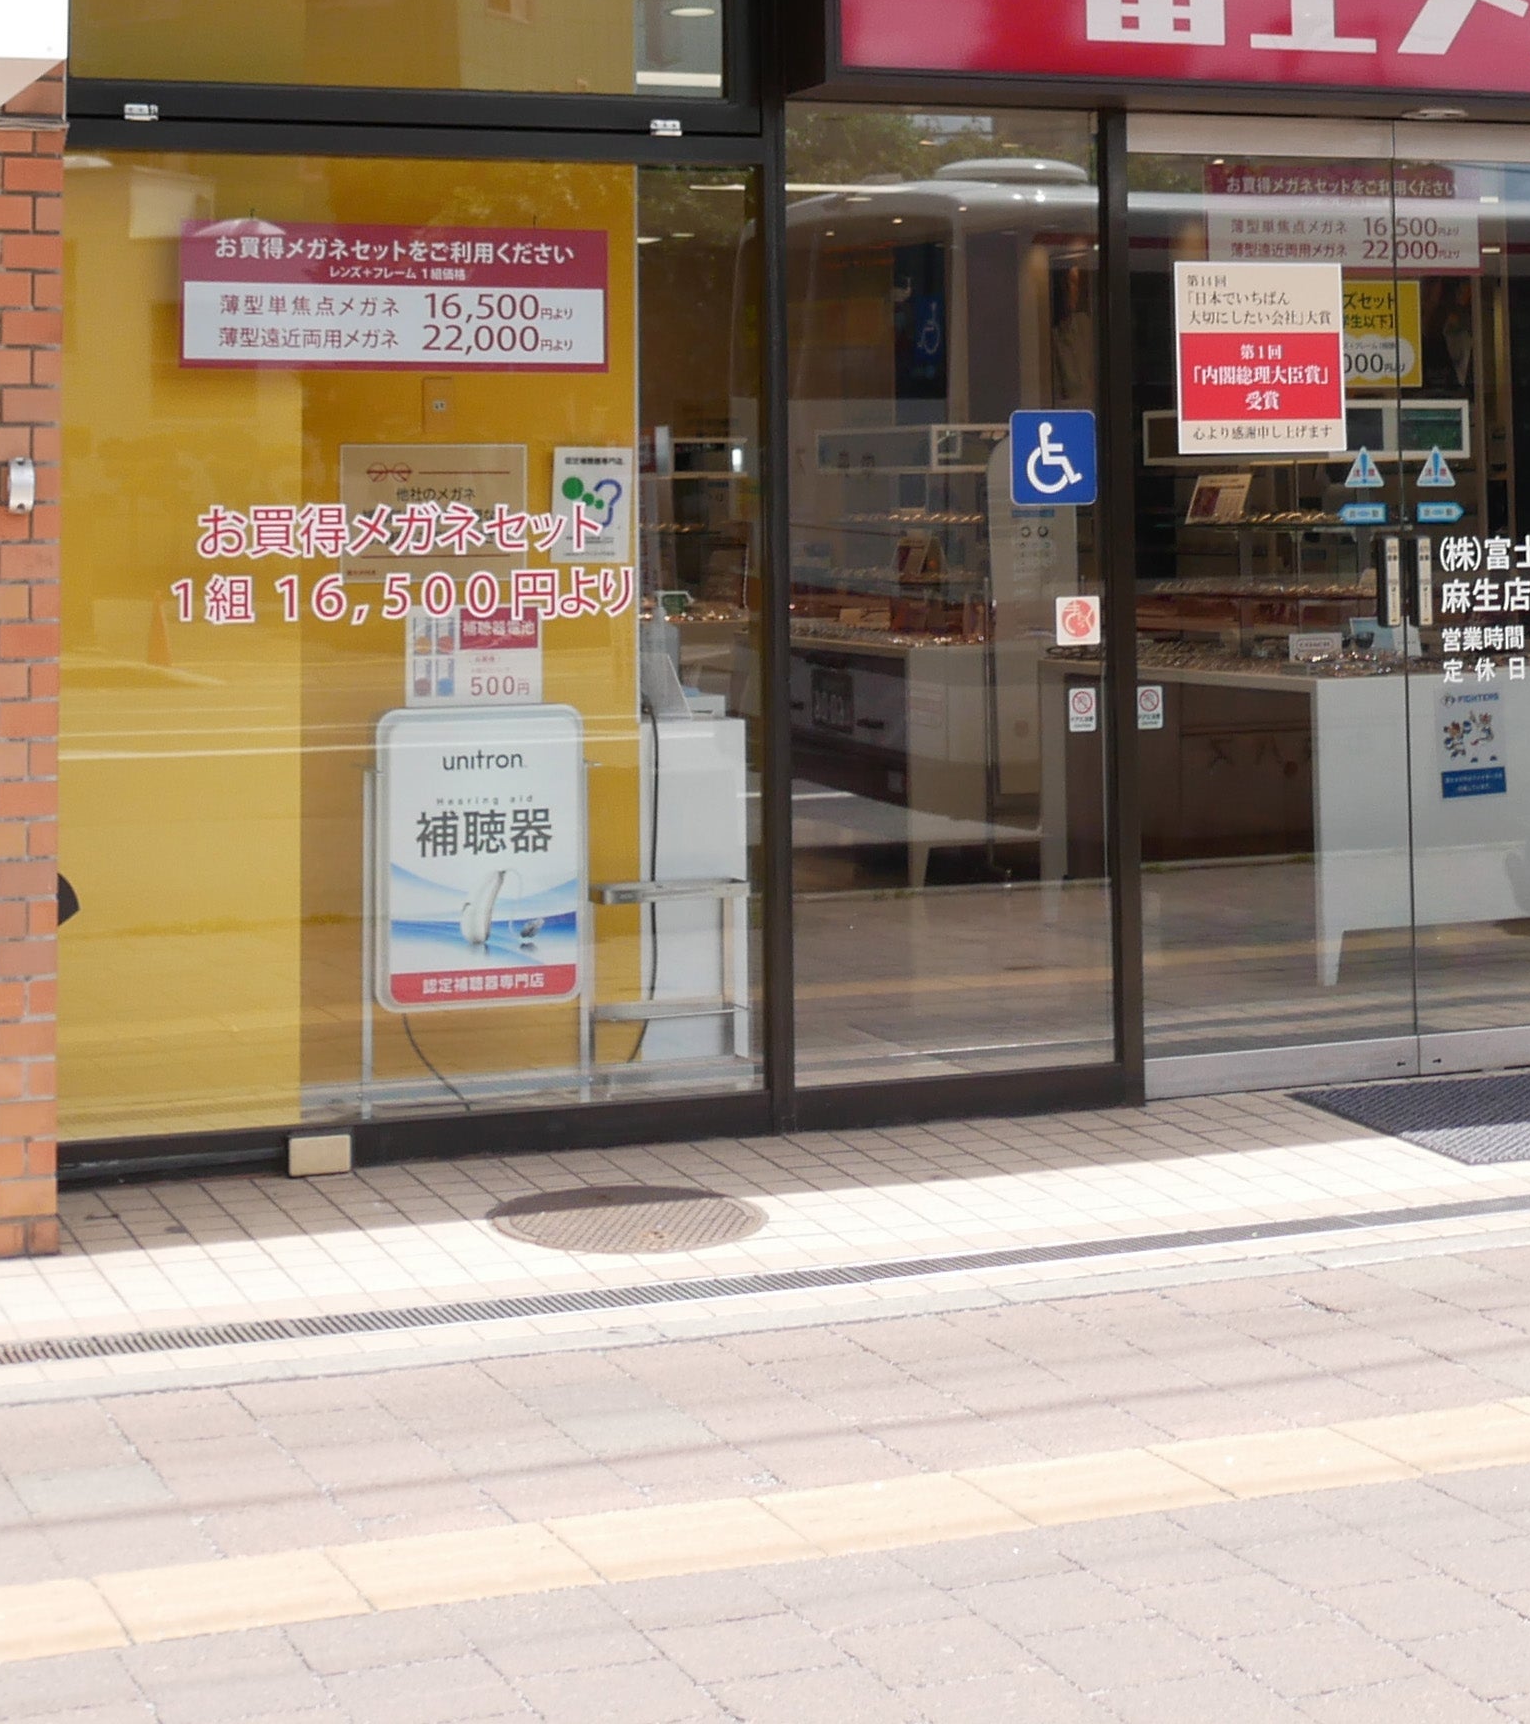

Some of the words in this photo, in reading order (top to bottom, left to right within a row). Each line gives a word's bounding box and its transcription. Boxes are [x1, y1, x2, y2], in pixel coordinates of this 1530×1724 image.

[214, 234, 575, 265] お買得メガネセットをご利用ください
[219, 293, 401, 318] 薄型単焦点メガネ
[423, 292, 575, 323] 16,500円より
[1189, 310, 1331, 325] 大切にしたい会社」大賞
[218, 326, 400, 350] 薄型遠近両用メガネ
[421, 324, 575, 354] 22,000円より
[1240, 344, 1282, 360] 第1回
[1193, 365, 1329, 385] 「内閣総理大臣賞」
[1245, 390, 1280, 411] 受賞
[1193, 425, 1332, 441] 心より感謝申し上げます
[196, 501, 603, 559] お買得メガネセット
[1441, 625, 1525, 653] 営業時間
[442, 750, 523, 772] unitron
[416, 807, 553, 859] 補聴器
[422, 972, 545, 996] 認定補聴器専門店
